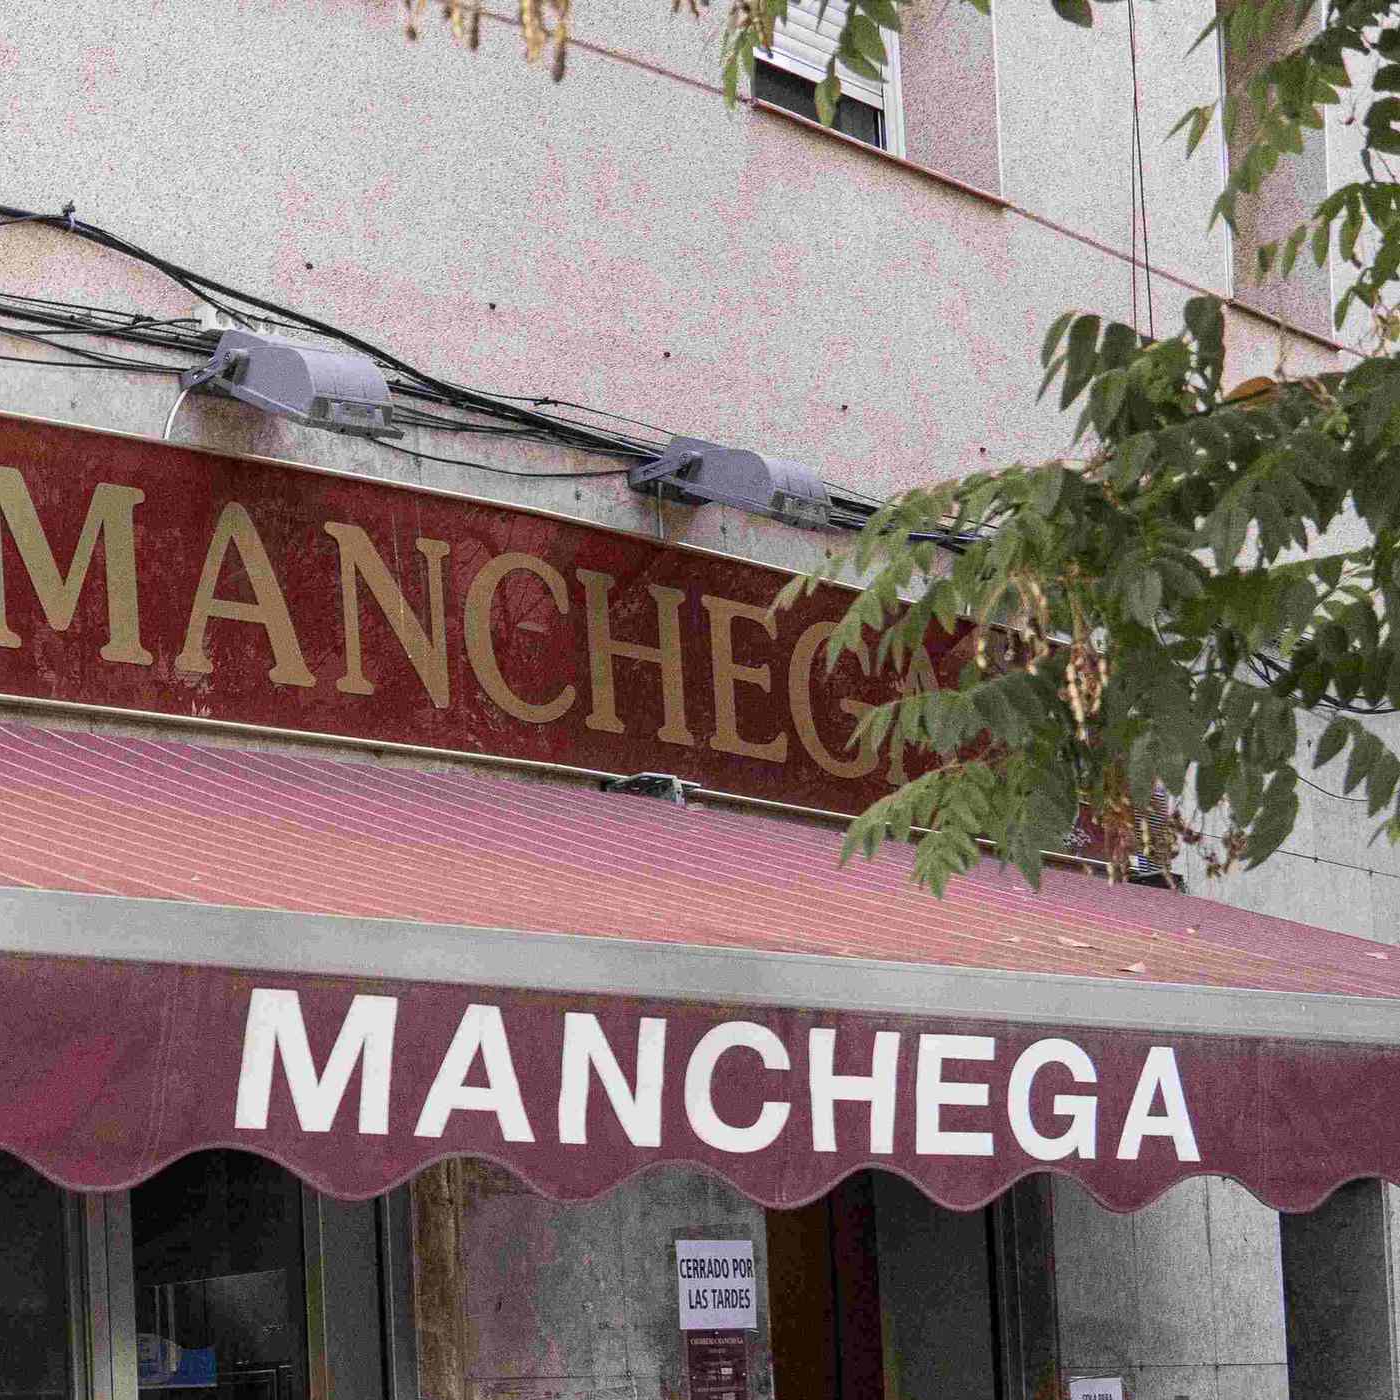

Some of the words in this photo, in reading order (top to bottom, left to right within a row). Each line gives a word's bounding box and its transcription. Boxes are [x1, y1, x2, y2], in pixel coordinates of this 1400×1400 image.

[233, 987, 1201, 1163] MANCHEGA
[680, 1258, 730, 1278] CERRADO
[732, 1258, 754, 1278] POR
[688, 1289, 709, 1309] LAS
[711, 1288, 751, 1309] TARDES
